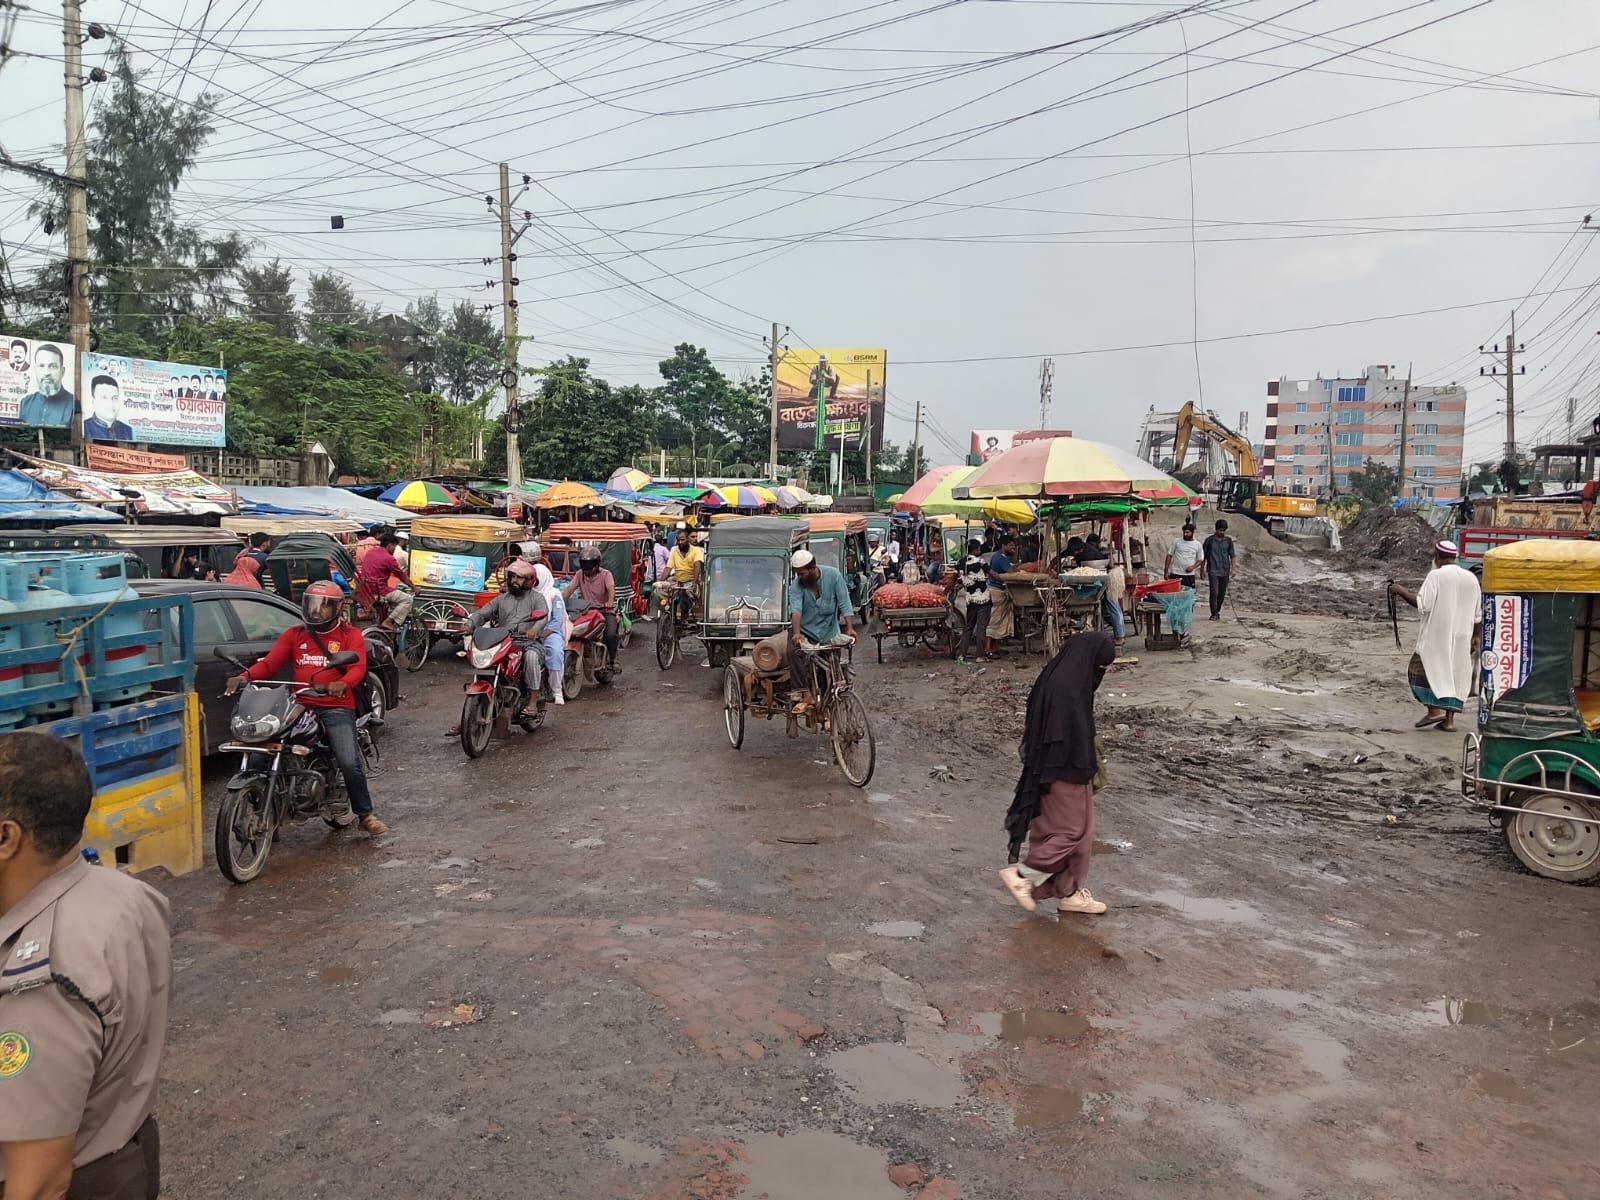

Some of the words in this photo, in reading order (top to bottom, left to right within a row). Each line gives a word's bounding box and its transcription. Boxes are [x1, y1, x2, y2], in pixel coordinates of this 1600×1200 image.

[176, 397, 225, 415] চেয়ারম্যান
[1500, 598, 1519, 653] ক্যাডেট
[302, 653, 324, 661] Team
